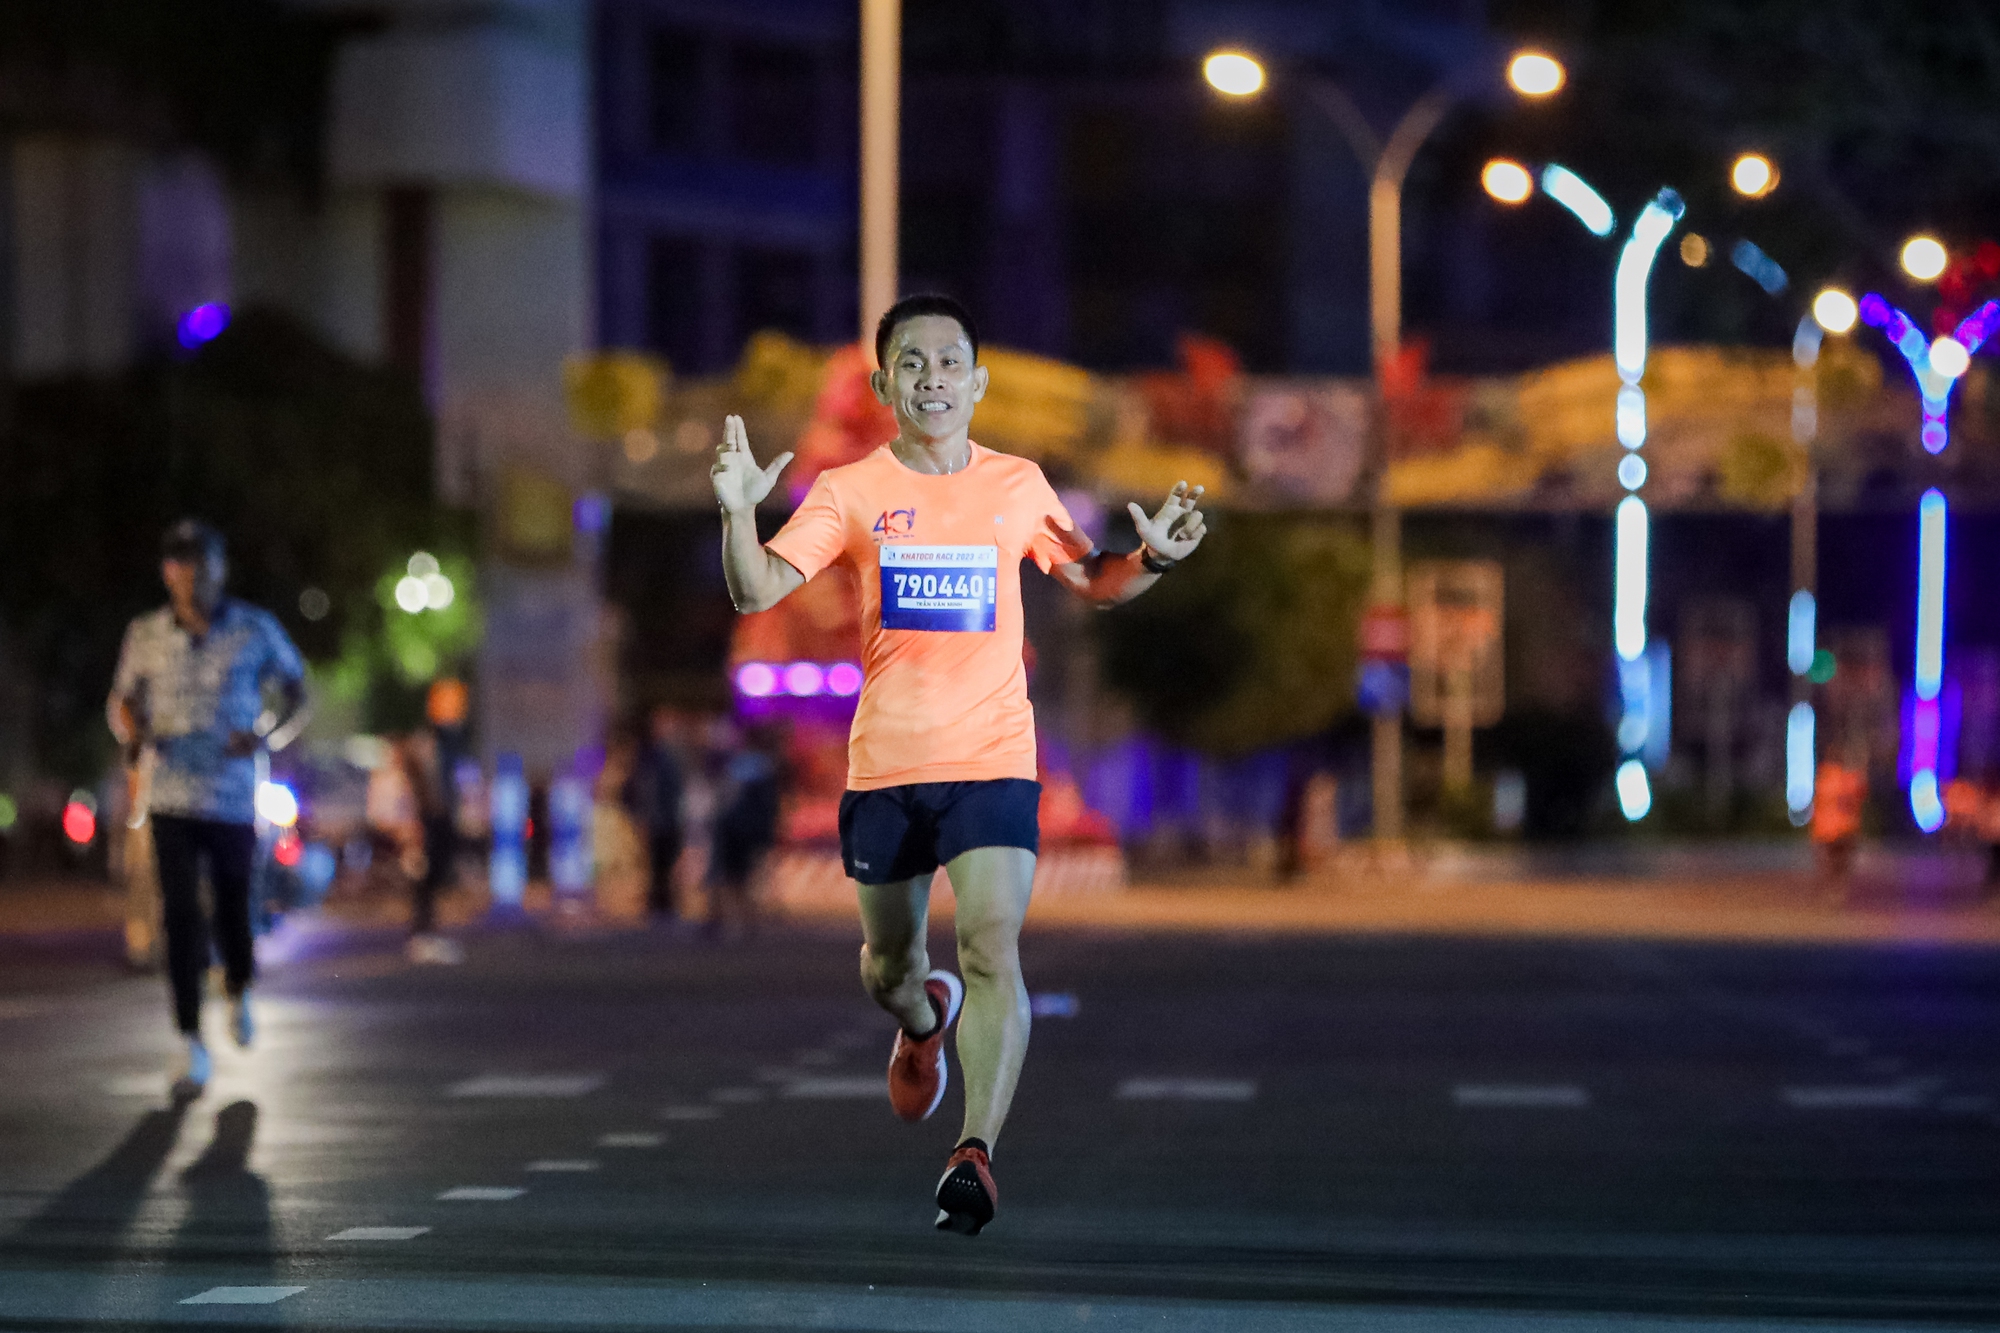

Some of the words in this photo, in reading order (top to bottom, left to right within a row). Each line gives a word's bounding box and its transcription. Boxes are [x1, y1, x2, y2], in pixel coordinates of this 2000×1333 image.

[901, 552, 934, 561] KHATOCO
[936, 552, 954, 561] RACE
[956, 552, 975, 561] 2023
[893, 573, 984, 598] 790440
